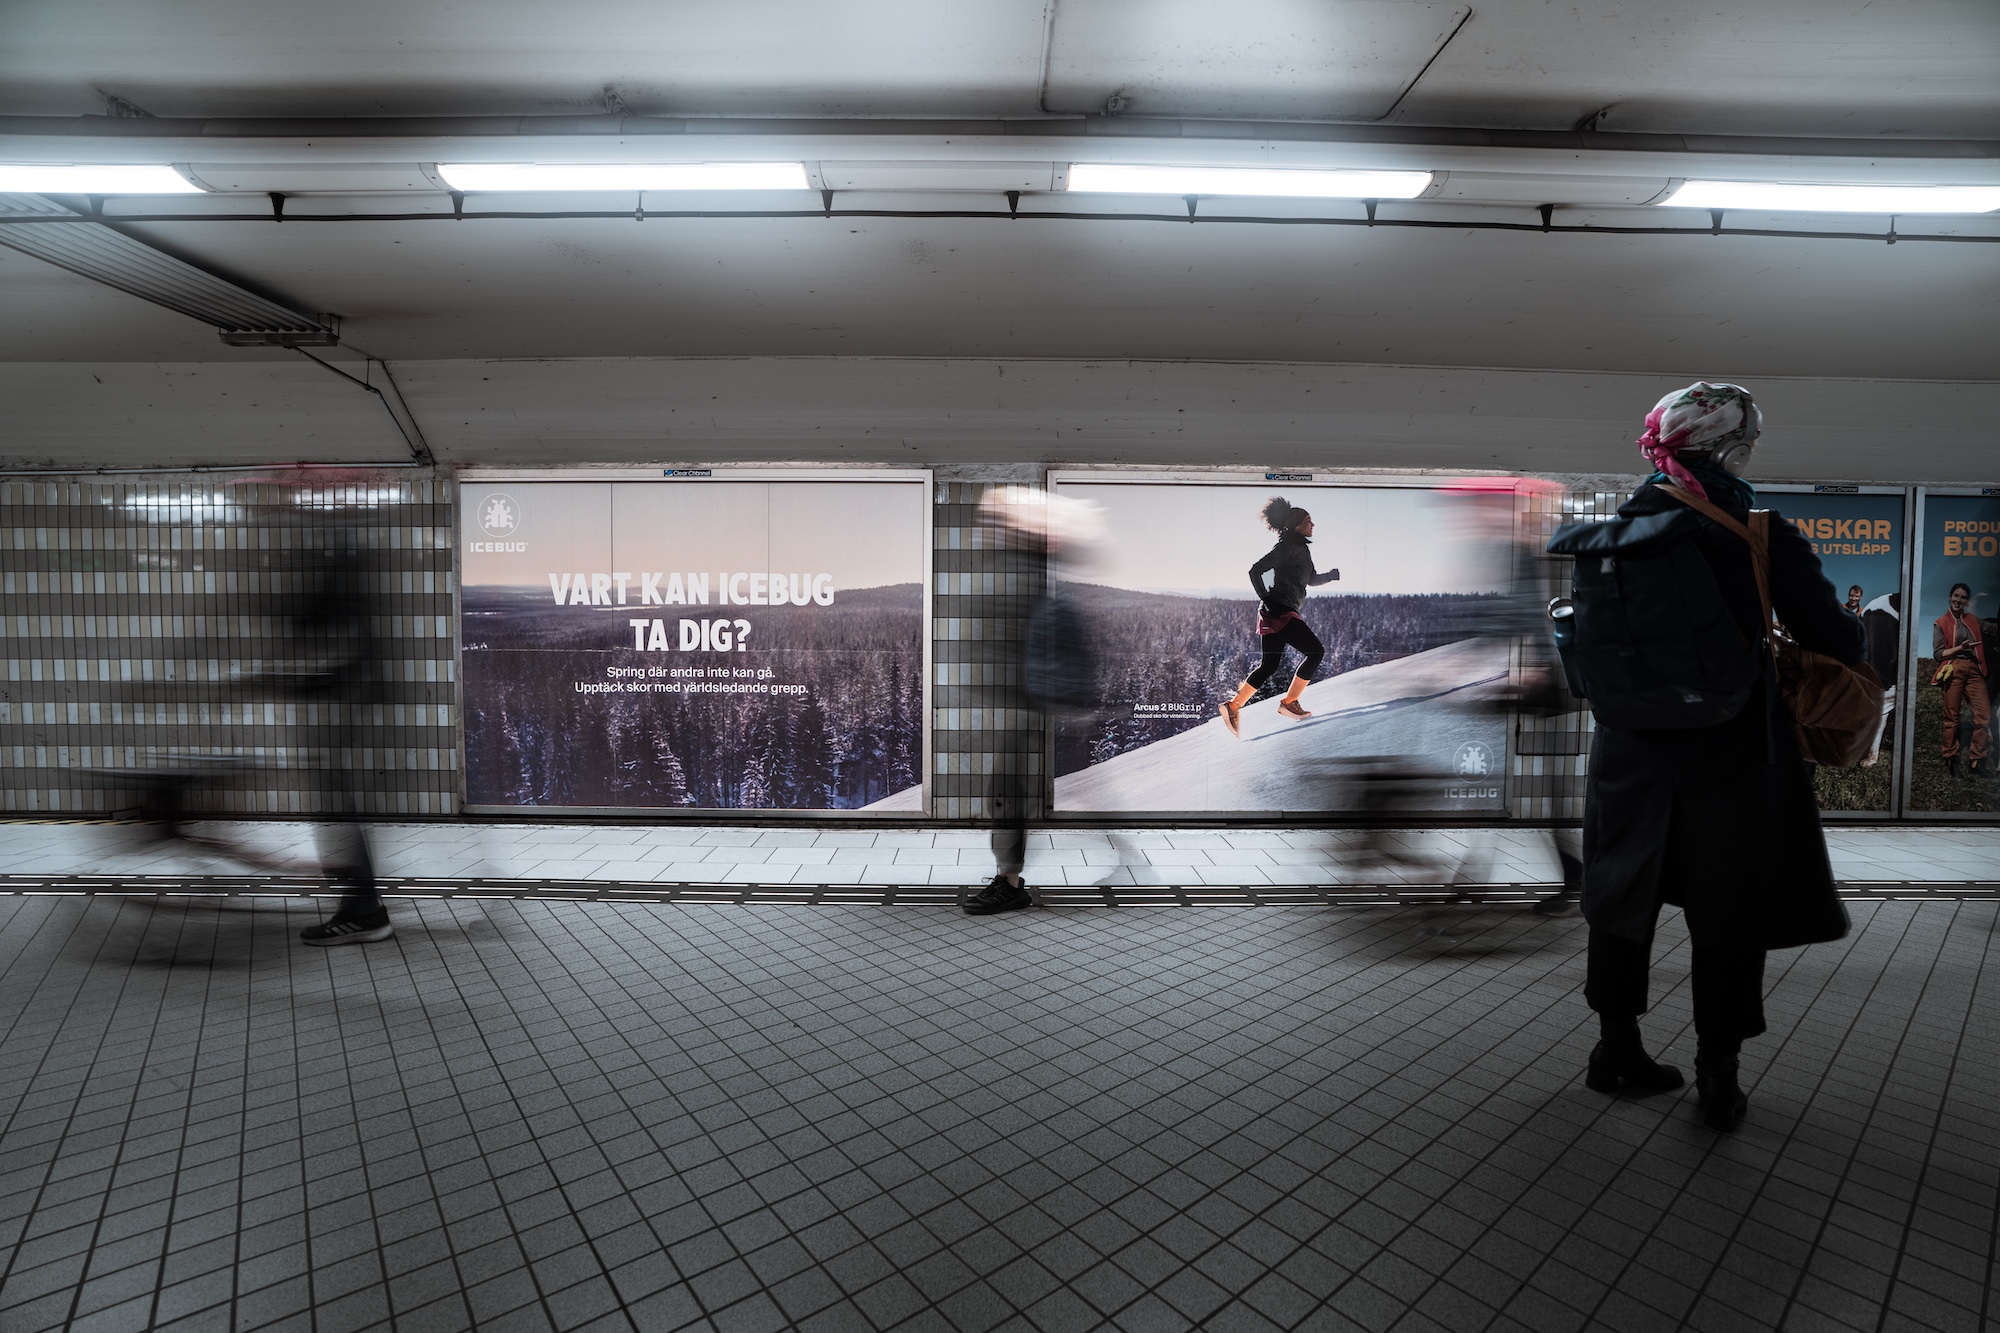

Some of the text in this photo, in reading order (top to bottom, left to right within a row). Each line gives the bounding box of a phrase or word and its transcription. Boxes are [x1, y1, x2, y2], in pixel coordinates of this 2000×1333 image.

[1787, 518, 1892, 540] NSKAR
[470, 542, 526, 552] ICEBUG
[1822, 542, 1891, 555] UTSLÄPP
[1944, 536, 2000, 557] BIO
[548, 572, 835, 606] VART KAN ICEBUG
[629, 618, 752, 652] TA DIG?
[607, 666, 776, 679] Spring där andra inte kan gå.
[574, 682, 809, 695] Upptäck skor med världsledande grepp.
[1133, 703, 1159, 711] Arcus
[1161, 703, 1166, 711] 2
[1444, 788, 1498, 798] ICEBUG
